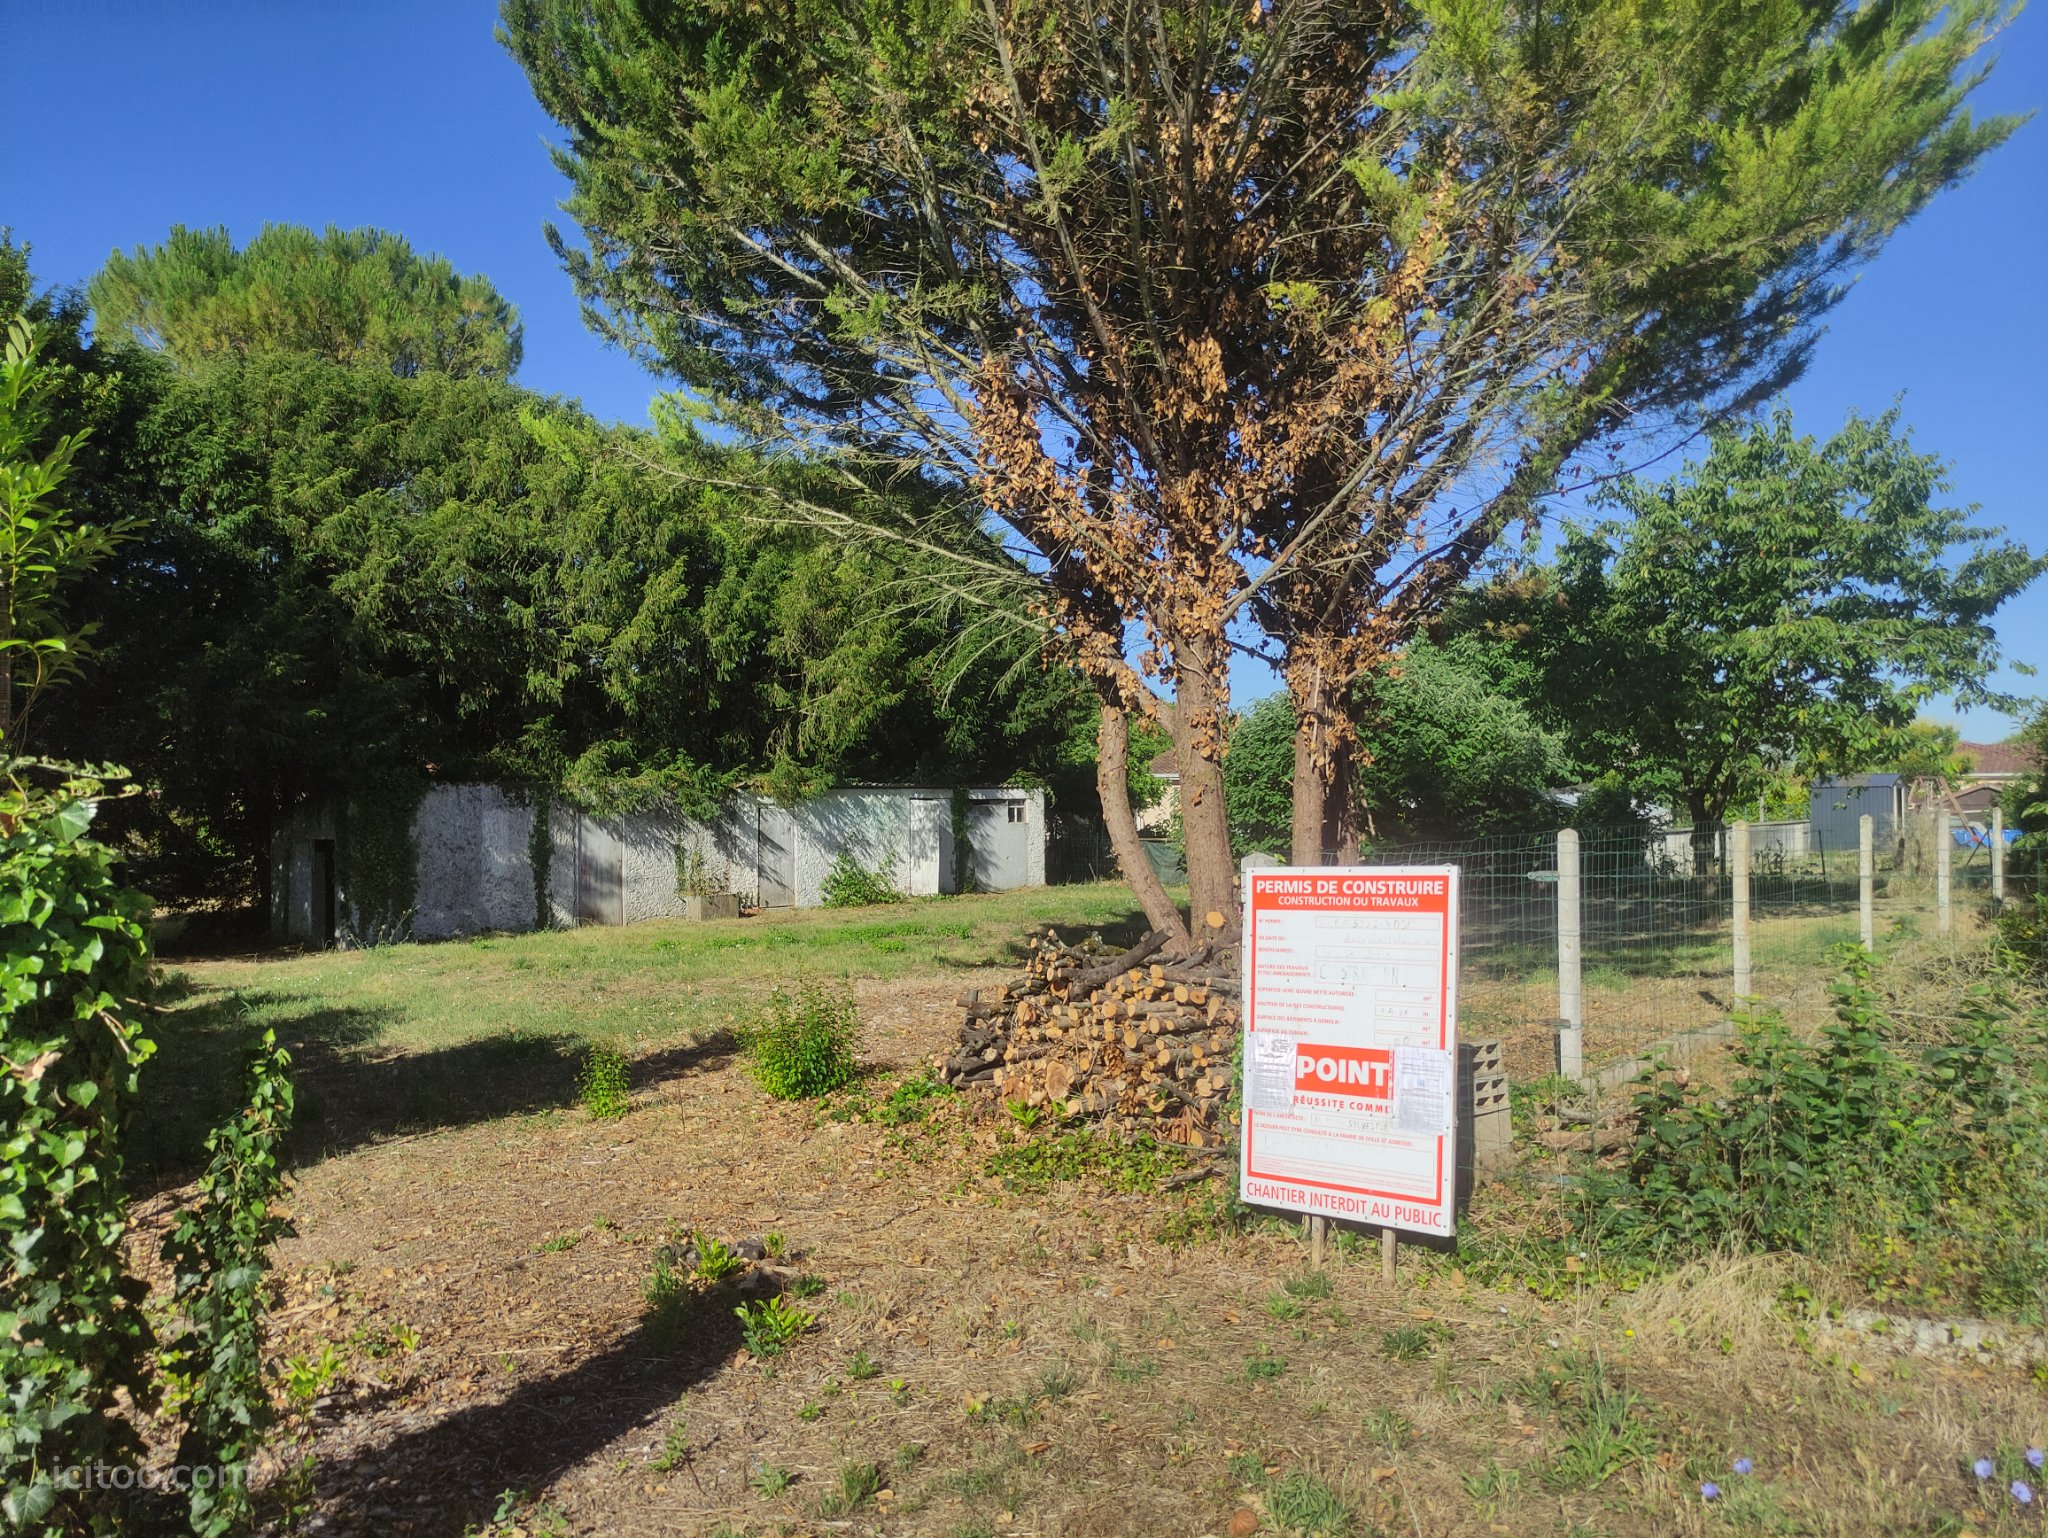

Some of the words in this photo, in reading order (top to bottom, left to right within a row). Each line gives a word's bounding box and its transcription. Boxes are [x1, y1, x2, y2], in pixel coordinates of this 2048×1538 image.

[1256, 880, 1312, 894] PERMIS
[1316, 881, 1338, 894] DE
[1342, 880, 1444, 895] CONSTRUIRE
[1278, 896, 1350, 906] CONSTRUCTION
[1353, 896, 1367, 906] OU
[1370, 897, 1418, 907] TRAVAUX
[1296, 1055, 1389, 1088] POINT
[1294, 1094, 1344, 1110] RÉUSSITE
[1246, 1182, 1306, 1205] CHANTIER
[1310, 1192, 1367, 1215] INTERDIT
[1372, 1204, 1390, 1219] AU
[1395, 1206, 1442, 1228] PUBLIC
